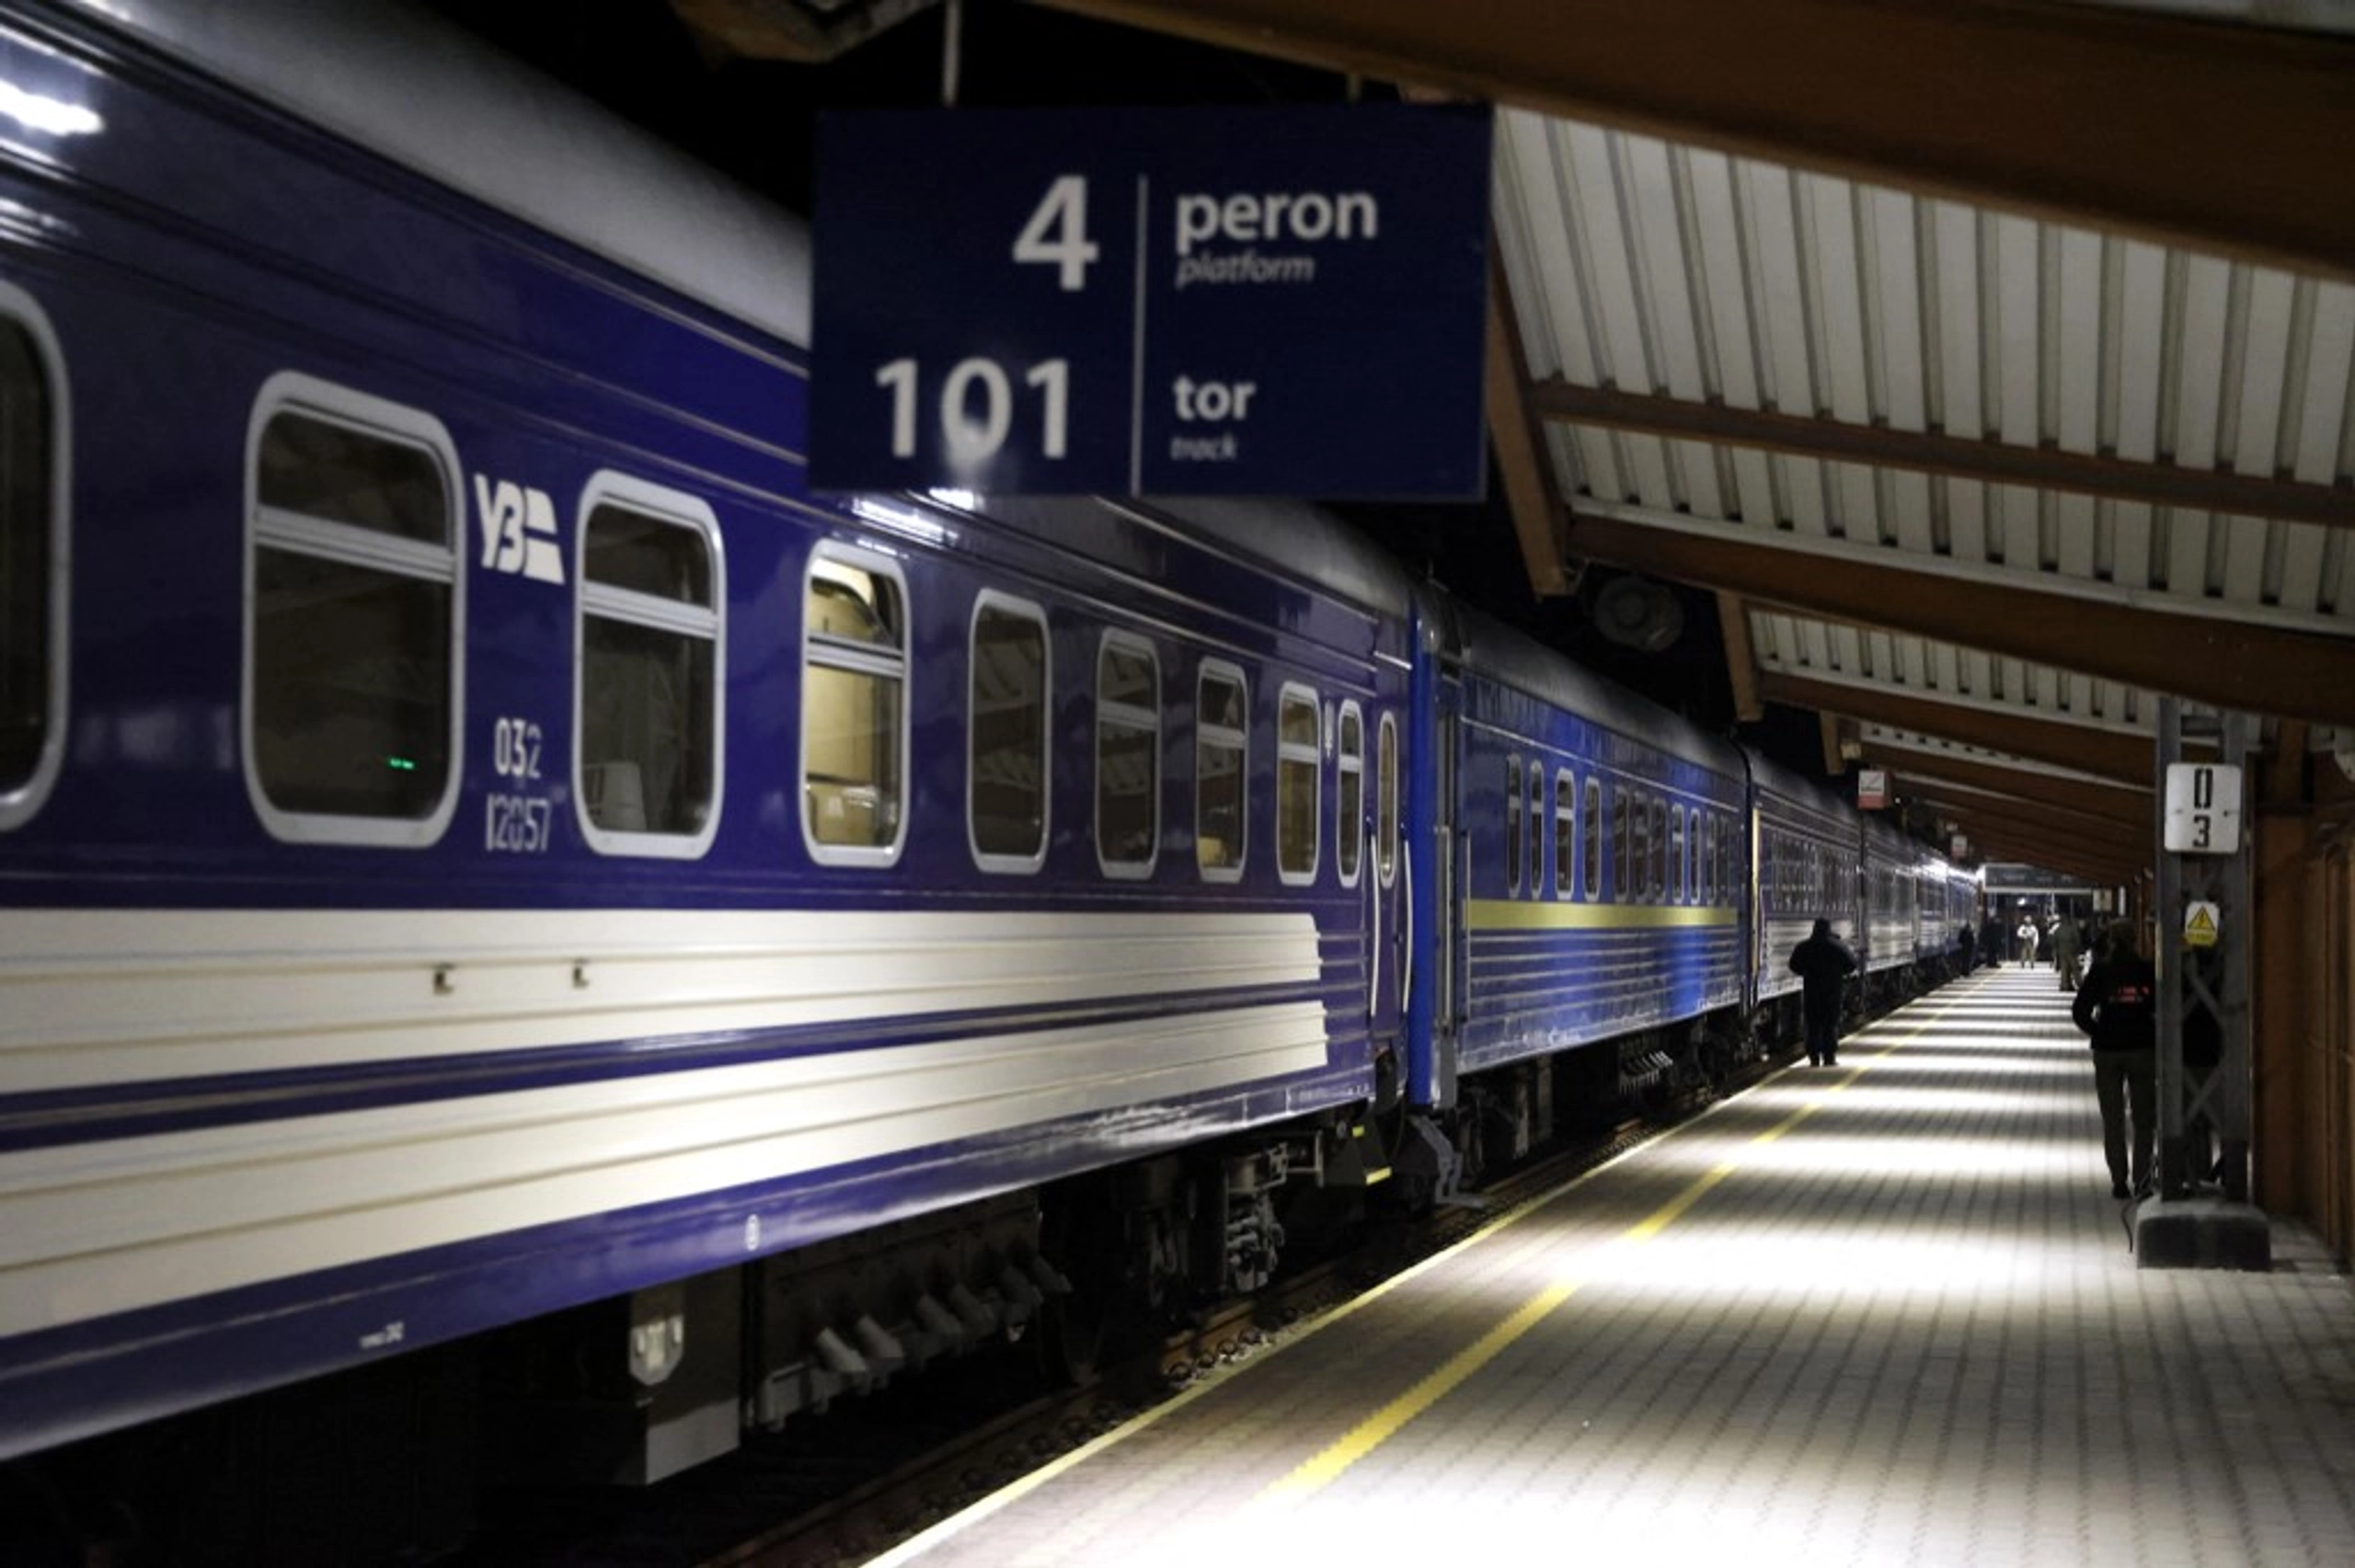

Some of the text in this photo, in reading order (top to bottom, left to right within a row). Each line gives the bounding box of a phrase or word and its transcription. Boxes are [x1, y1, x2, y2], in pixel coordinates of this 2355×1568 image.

[1013, 176, 1099, 291] 4
[1175, 191, 1379, 256] peron
[1175, 253, 1315, 290] platform
[875, 359, 1069, 460] 101
[1173, 375, 1254, 420] tor
[1171, 434, 1238, 462] track
[494, 715, 543, 779] 032
[2193, 815, 2211, 849] 3
